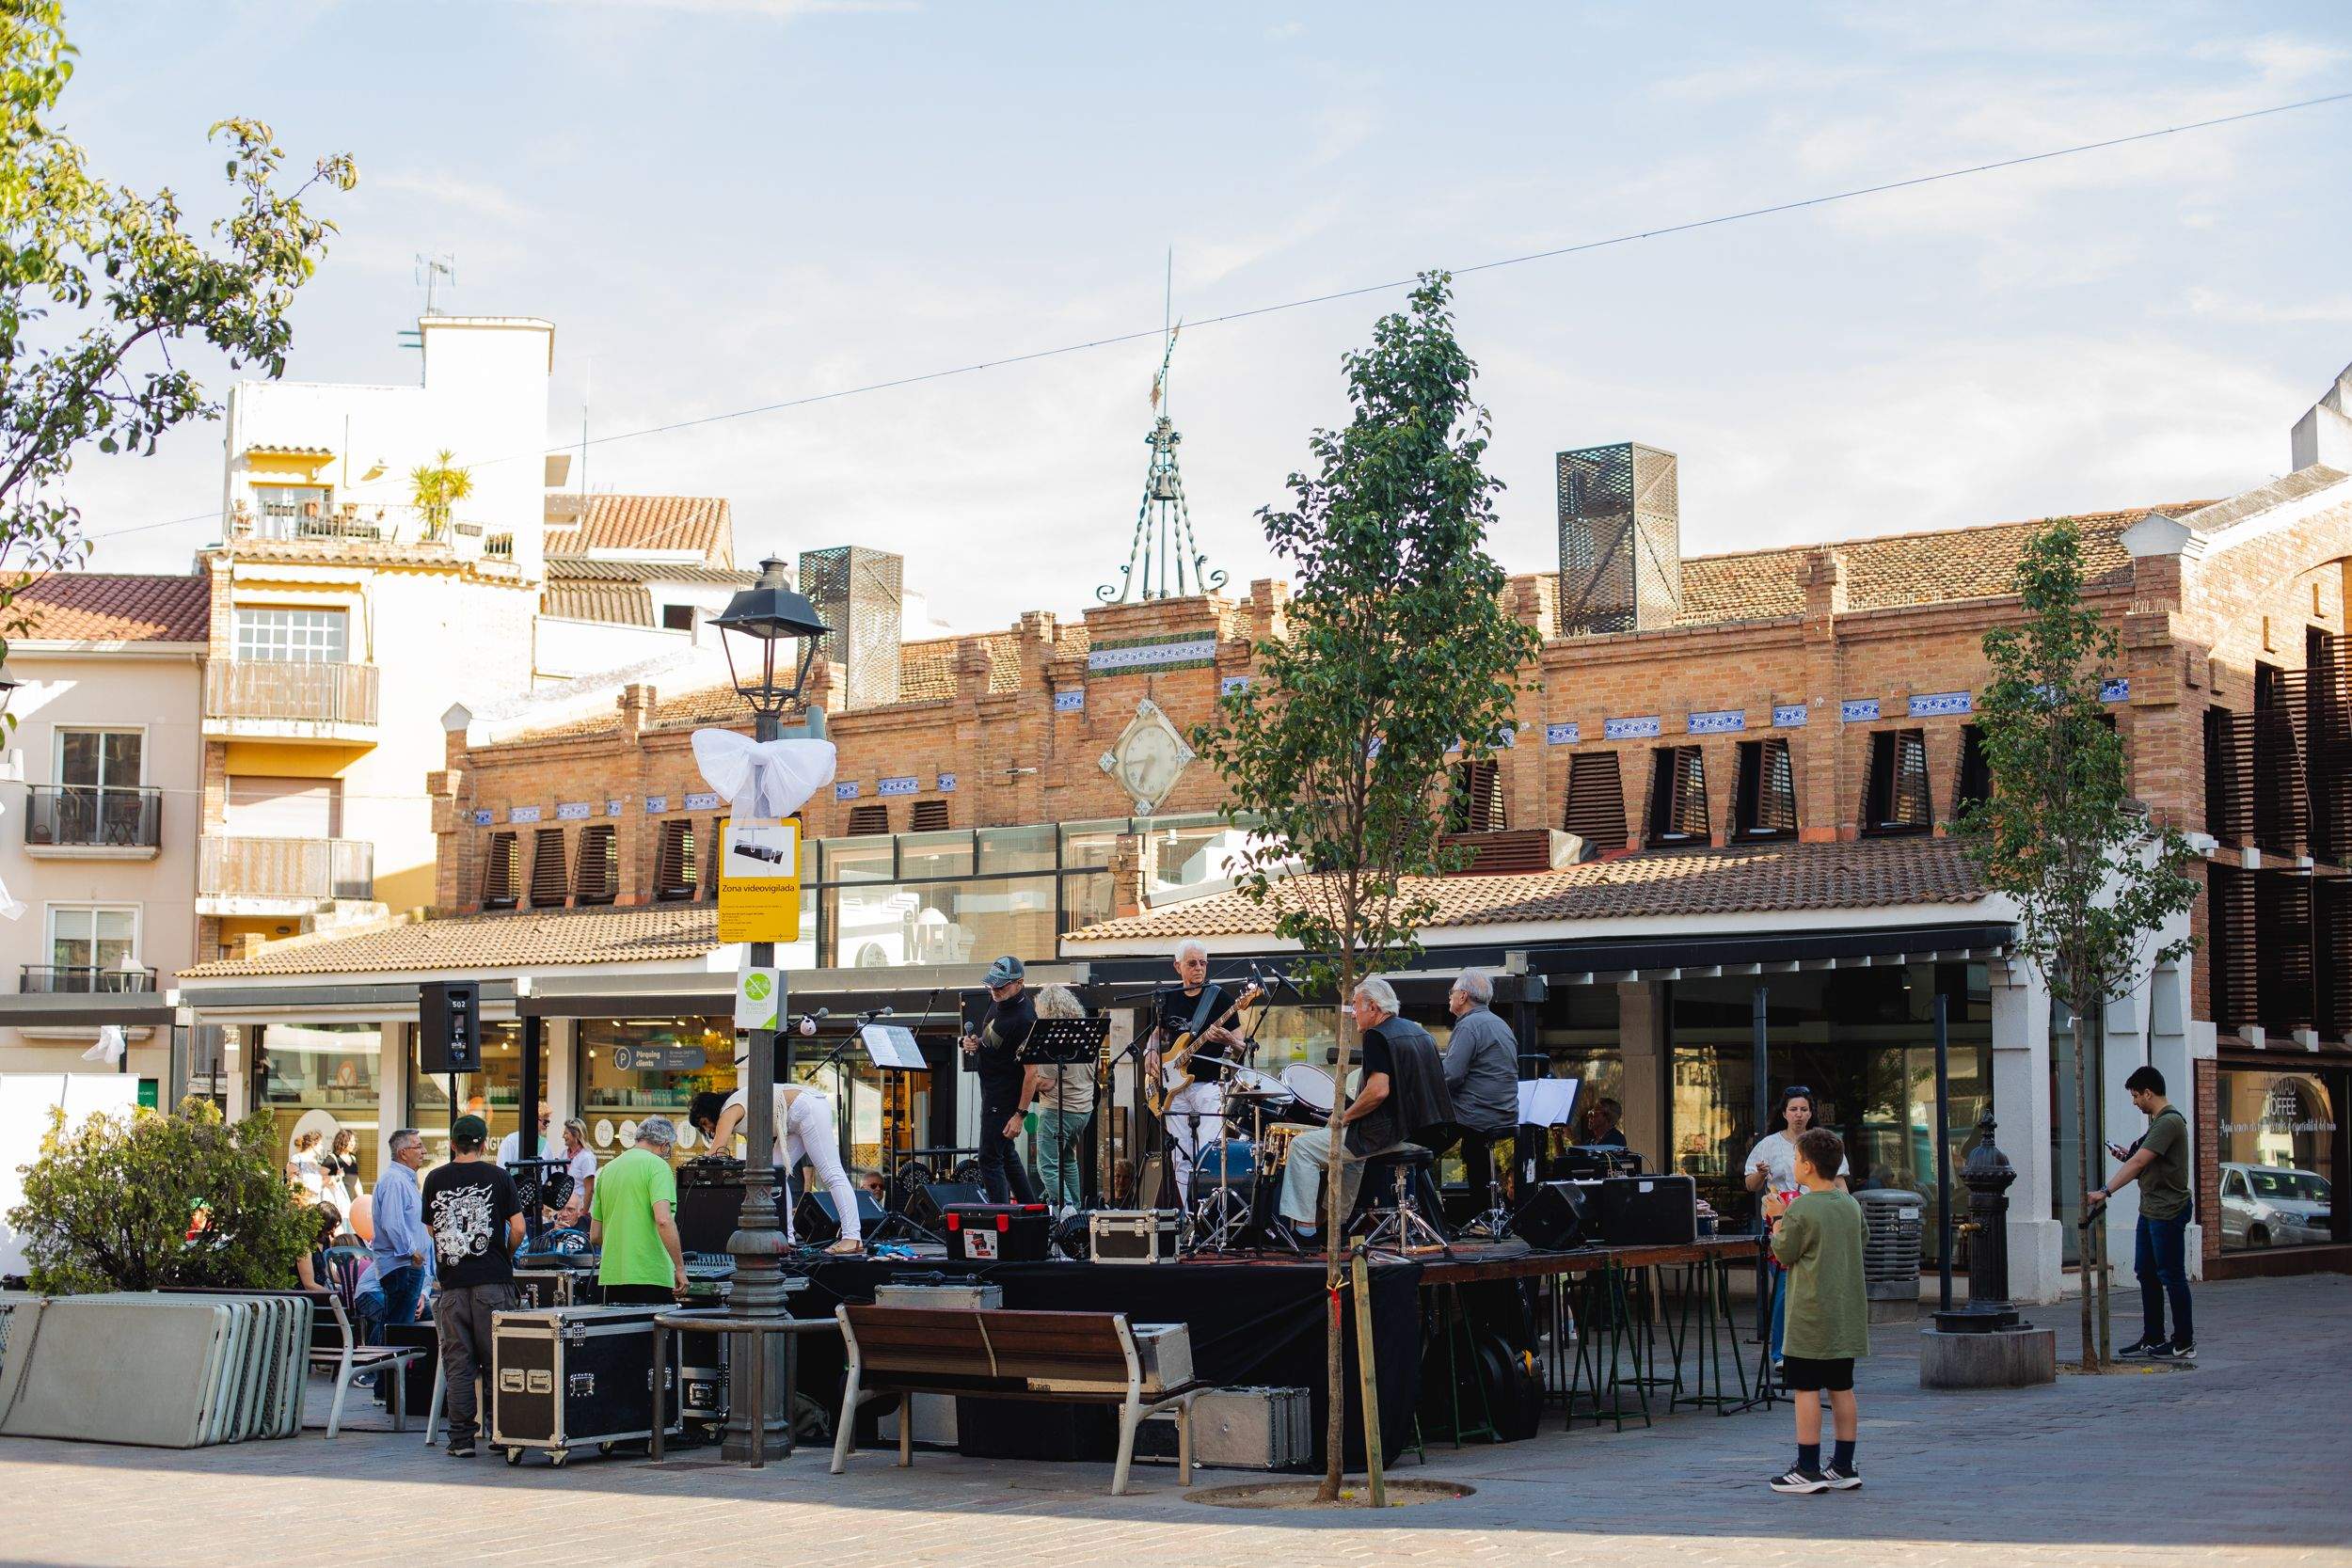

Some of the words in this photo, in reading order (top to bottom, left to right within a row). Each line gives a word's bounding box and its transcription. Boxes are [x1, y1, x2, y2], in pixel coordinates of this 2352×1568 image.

[722, 884, 742, 893] Zona
[743, 884, 795, 894] videovigilada
[1607, 1169, 1628, 1178] Roland
